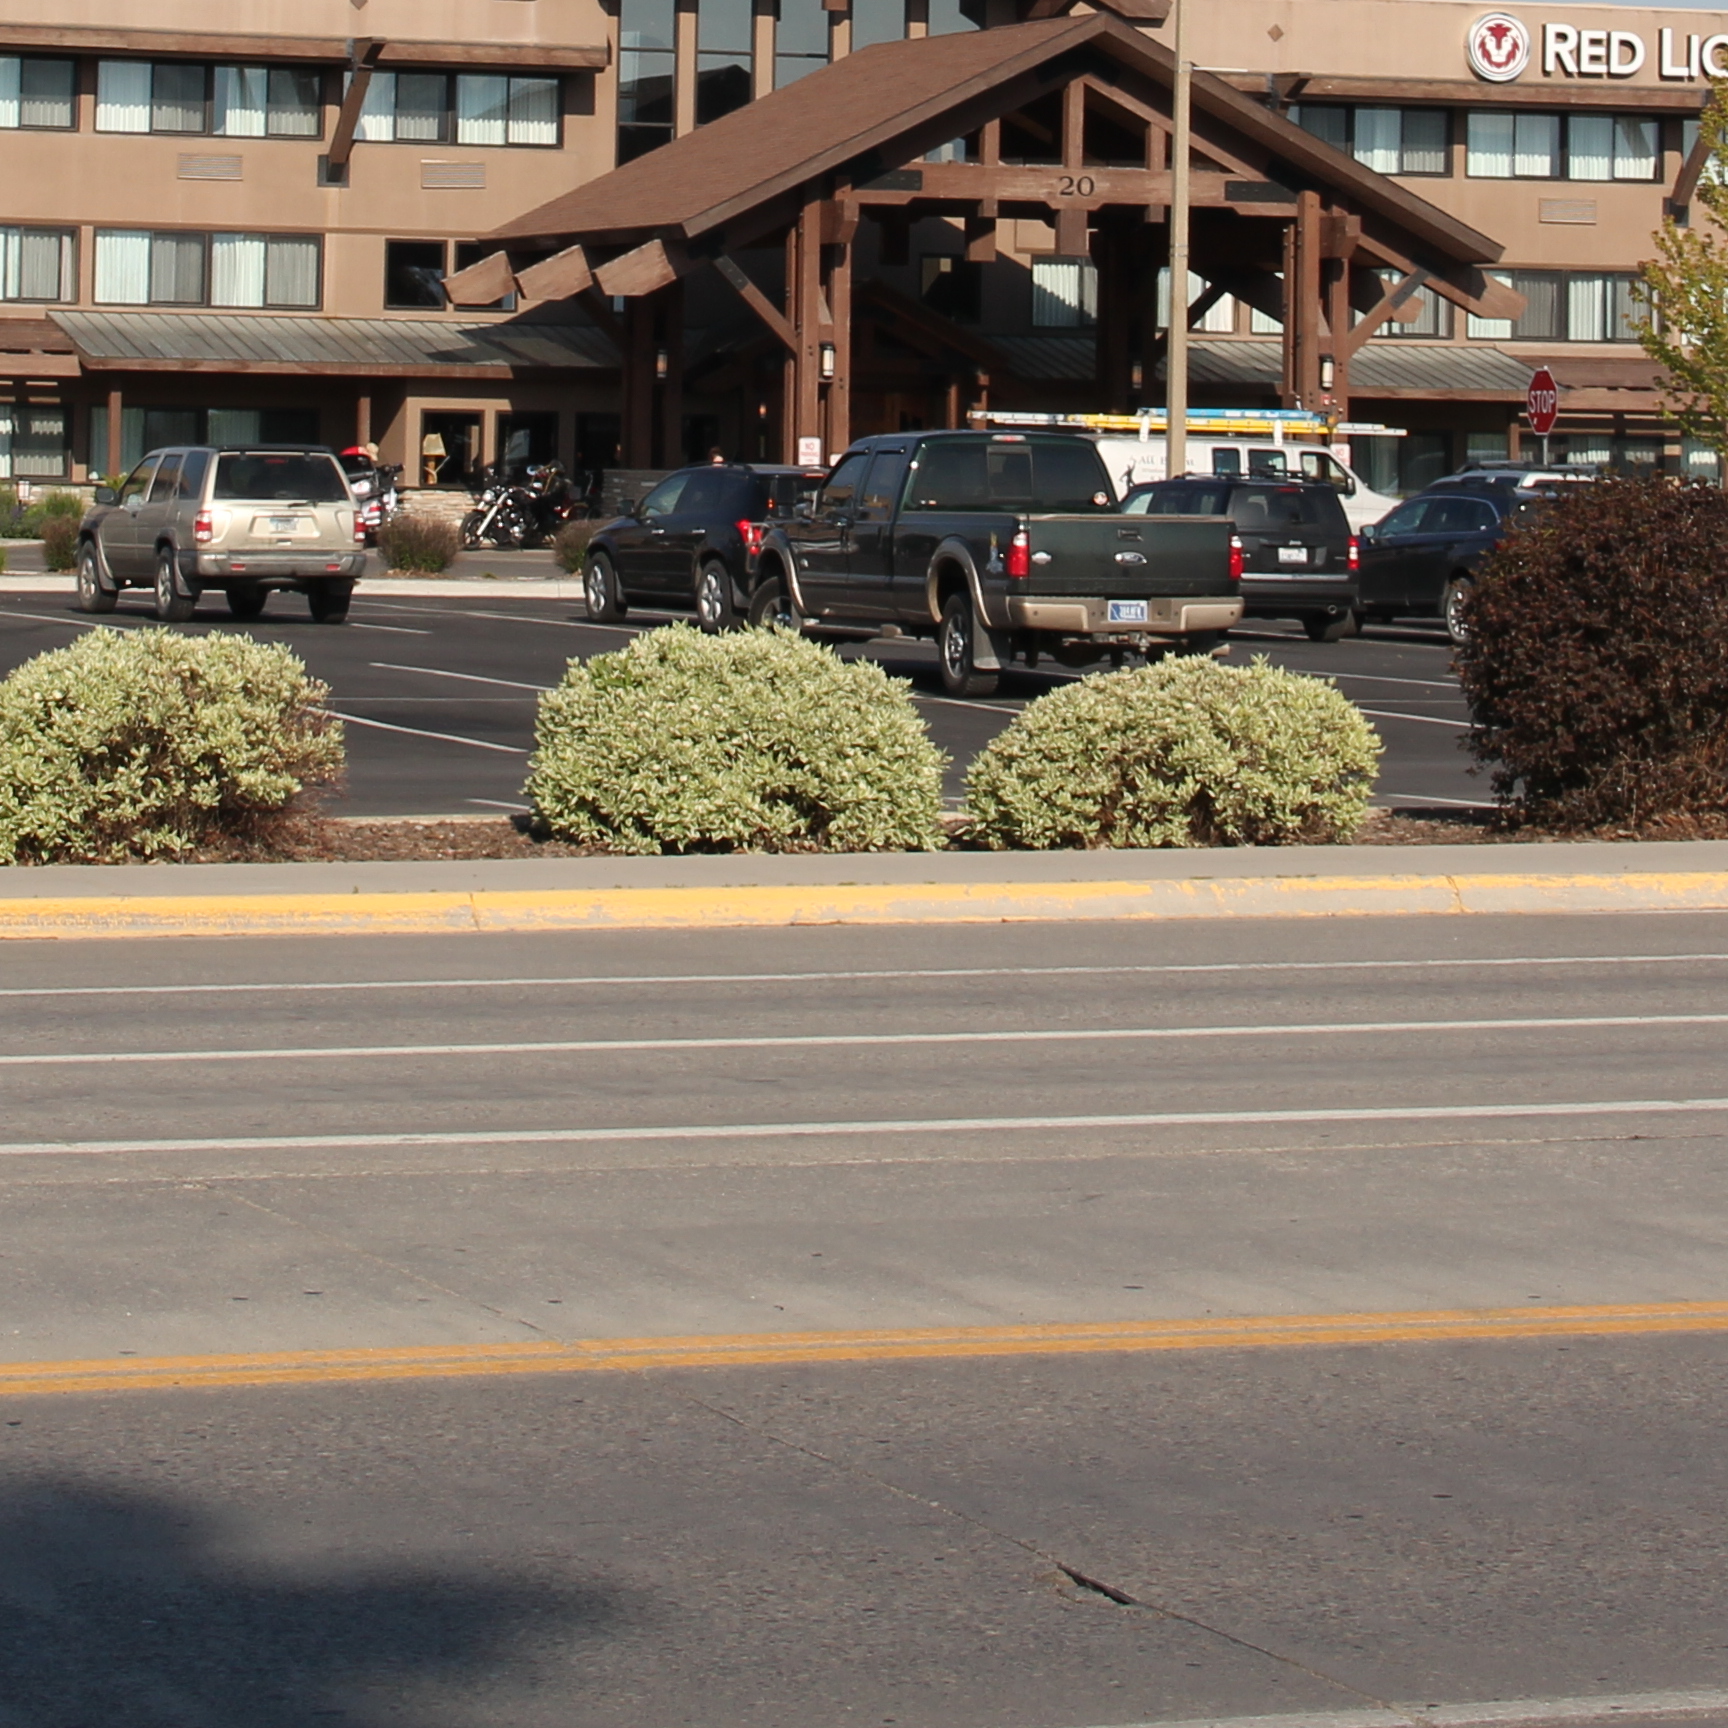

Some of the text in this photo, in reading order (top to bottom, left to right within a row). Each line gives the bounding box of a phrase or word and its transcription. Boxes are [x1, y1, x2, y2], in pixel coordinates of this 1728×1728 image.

[1544, 23, 1646, 75] RED
[1059, 176, 1095, 197] 20
[1529, 389, 1556, 414] STOP
